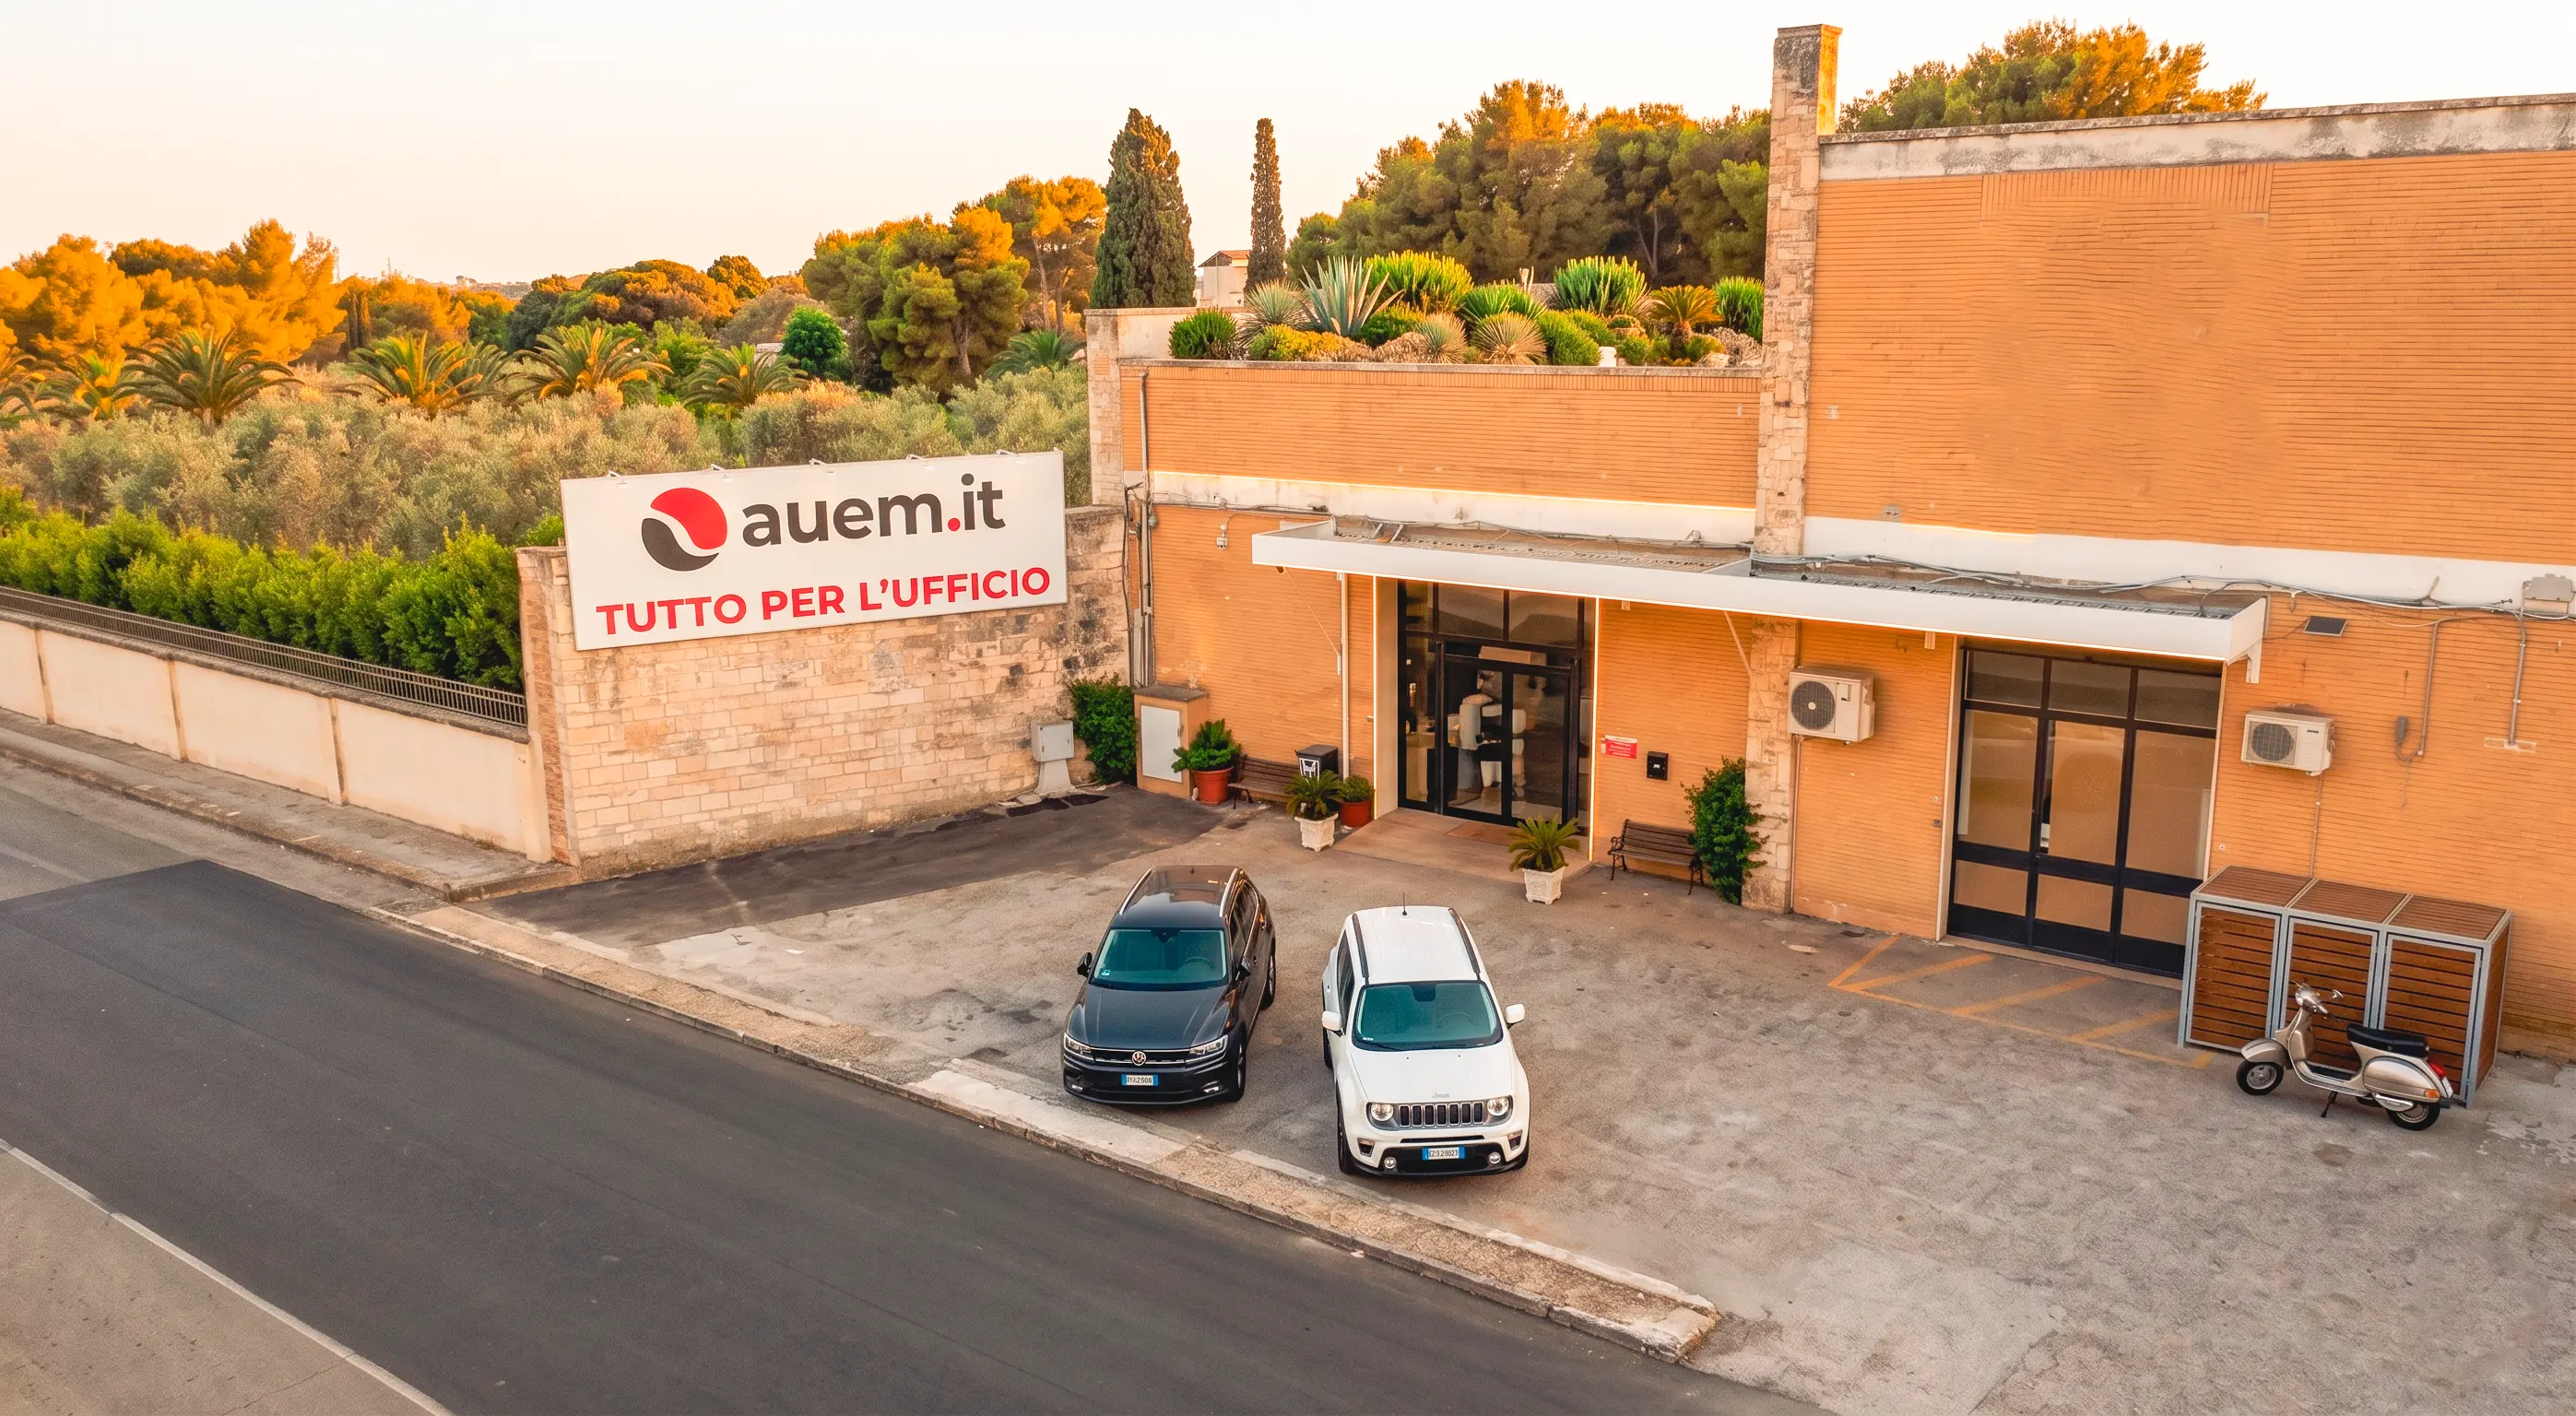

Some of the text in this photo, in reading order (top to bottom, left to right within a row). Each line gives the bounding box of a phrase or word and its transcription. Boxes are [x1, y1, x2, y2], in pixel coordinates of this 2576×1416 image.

[742, 473, 1006, 547] auem.it
[596, 566, 1052, 635] TUTTO PER L’UFFICIO
